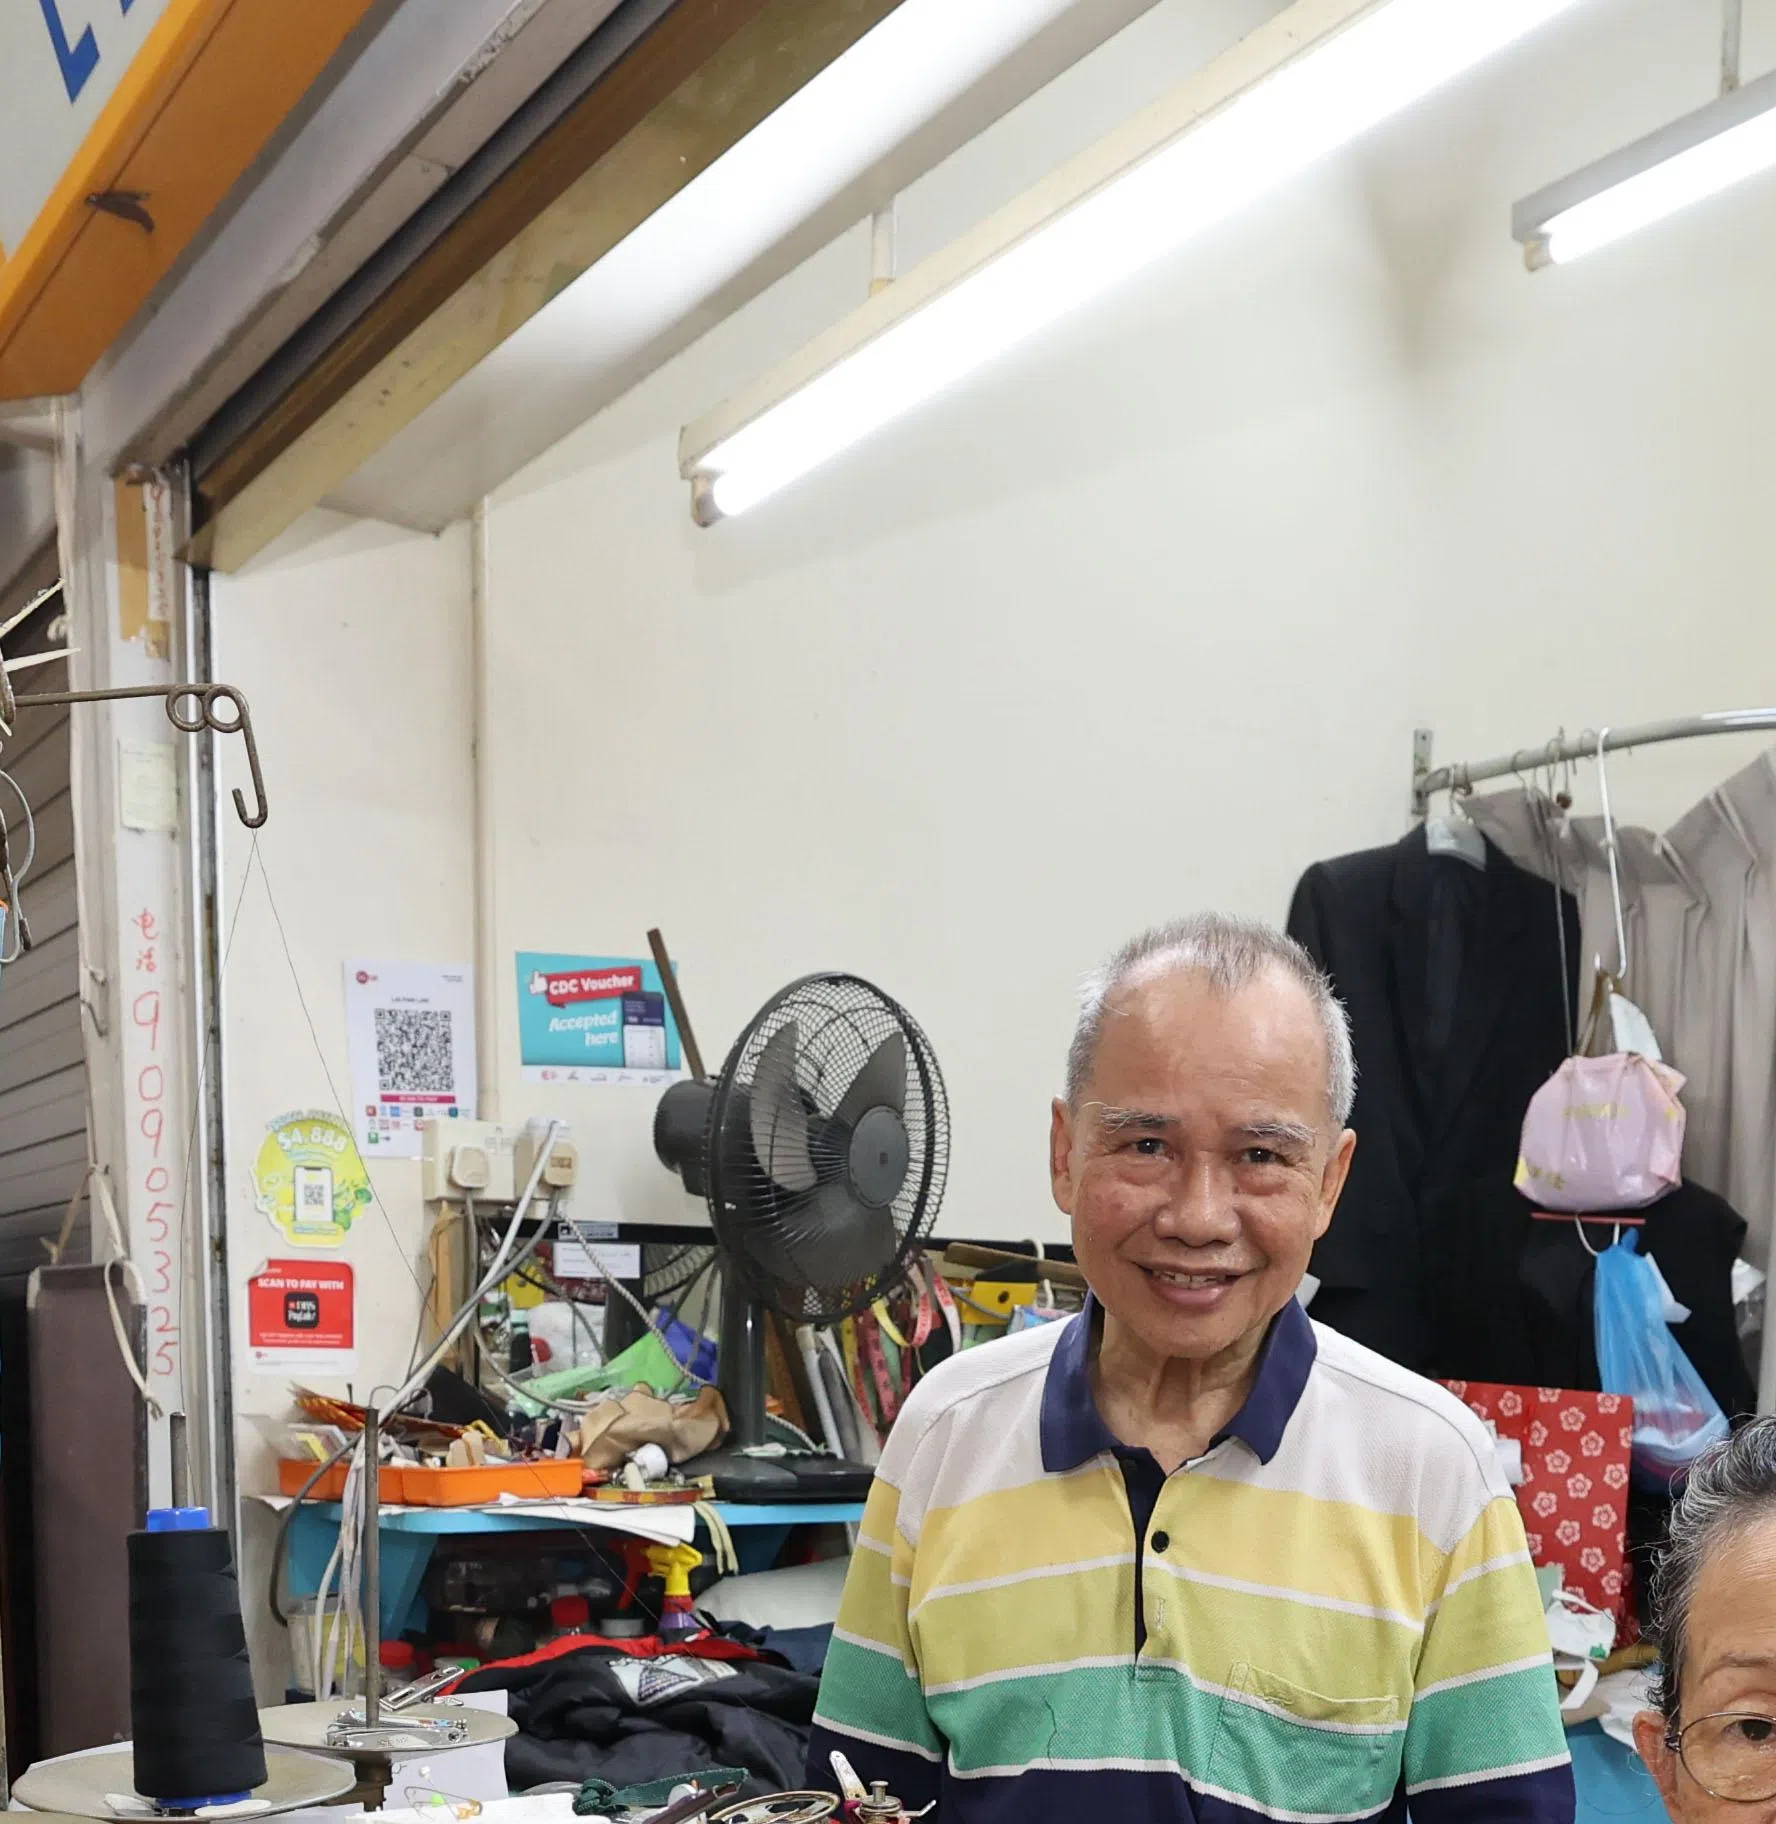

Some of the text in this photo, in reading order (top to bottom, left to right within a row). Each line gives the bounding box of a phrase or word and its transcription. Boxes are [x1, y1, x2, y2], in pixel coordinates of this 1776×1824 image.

[549, 974, 634, 995] CDC Voucher
[549, 1010, 616, 1032] Accepted
[584, 1032, 618, 1046] here
[258, 1278, 344, 1290] SCAN TO PAY WITH
